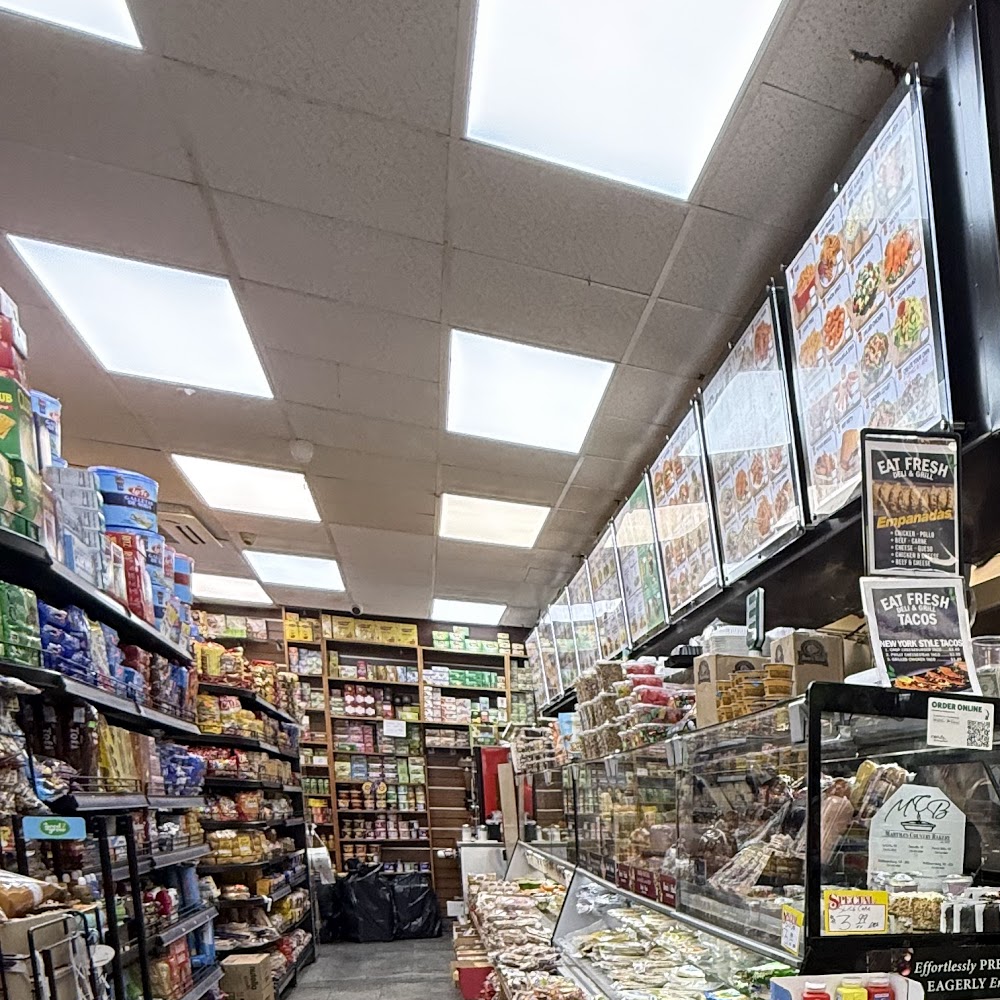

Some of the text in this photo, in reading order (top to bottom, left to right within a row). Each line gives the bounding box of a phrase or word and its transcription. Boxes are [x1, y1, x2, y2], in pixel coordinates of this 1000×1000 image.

[877, 457, 948, 478] EAT FRESH
[916, 471, 933, 480] GRILL
[877, 509, 952, 528] Empanadas
[895, 530, 915, 538] CHICKEN
[880, 593, 950, 611] EAT FRESH
[896, 605, 910, 613] DELI
[898, 613, 937, 625] TACOS
[932, 702, 982, 712] ORDER ONLINE
[829, 894, 875, 910] SPECIAL
[914, 961, 977, 976] Effortlessly
[927, 978, 987, 992] EAGERLY
